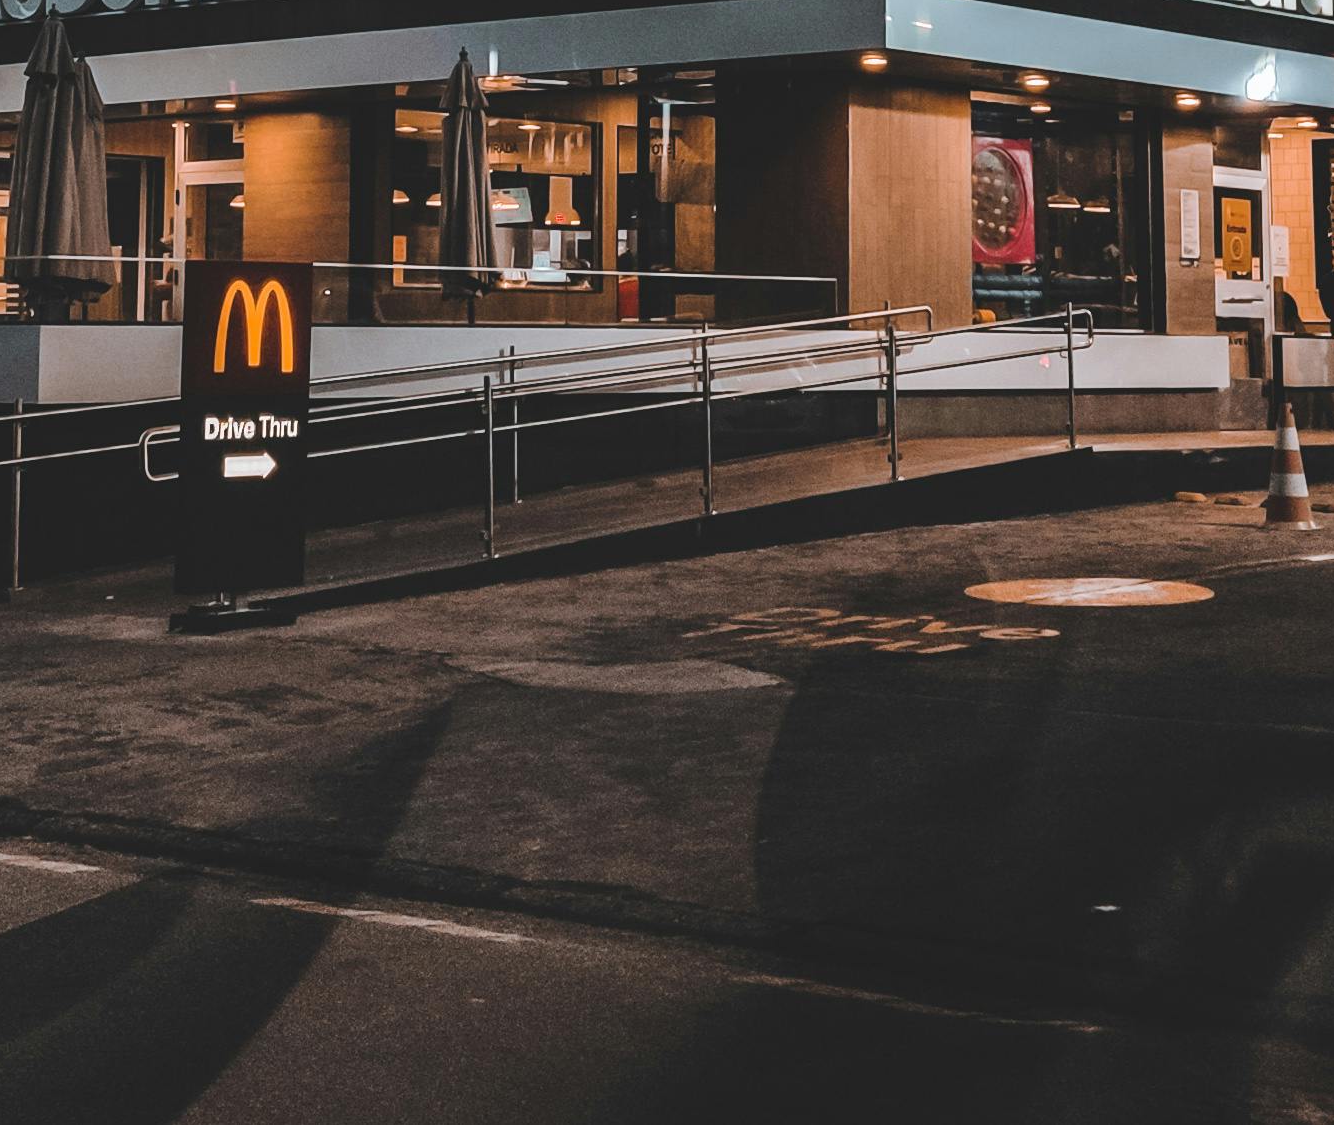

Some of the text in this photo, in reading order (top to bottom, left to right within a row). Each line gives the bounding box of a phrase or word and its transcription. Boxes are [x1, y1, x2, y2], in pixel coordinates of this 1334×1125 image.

[204, 415, 299, 440] Drive Thru
[729, 606, 1061, 641] Drive
